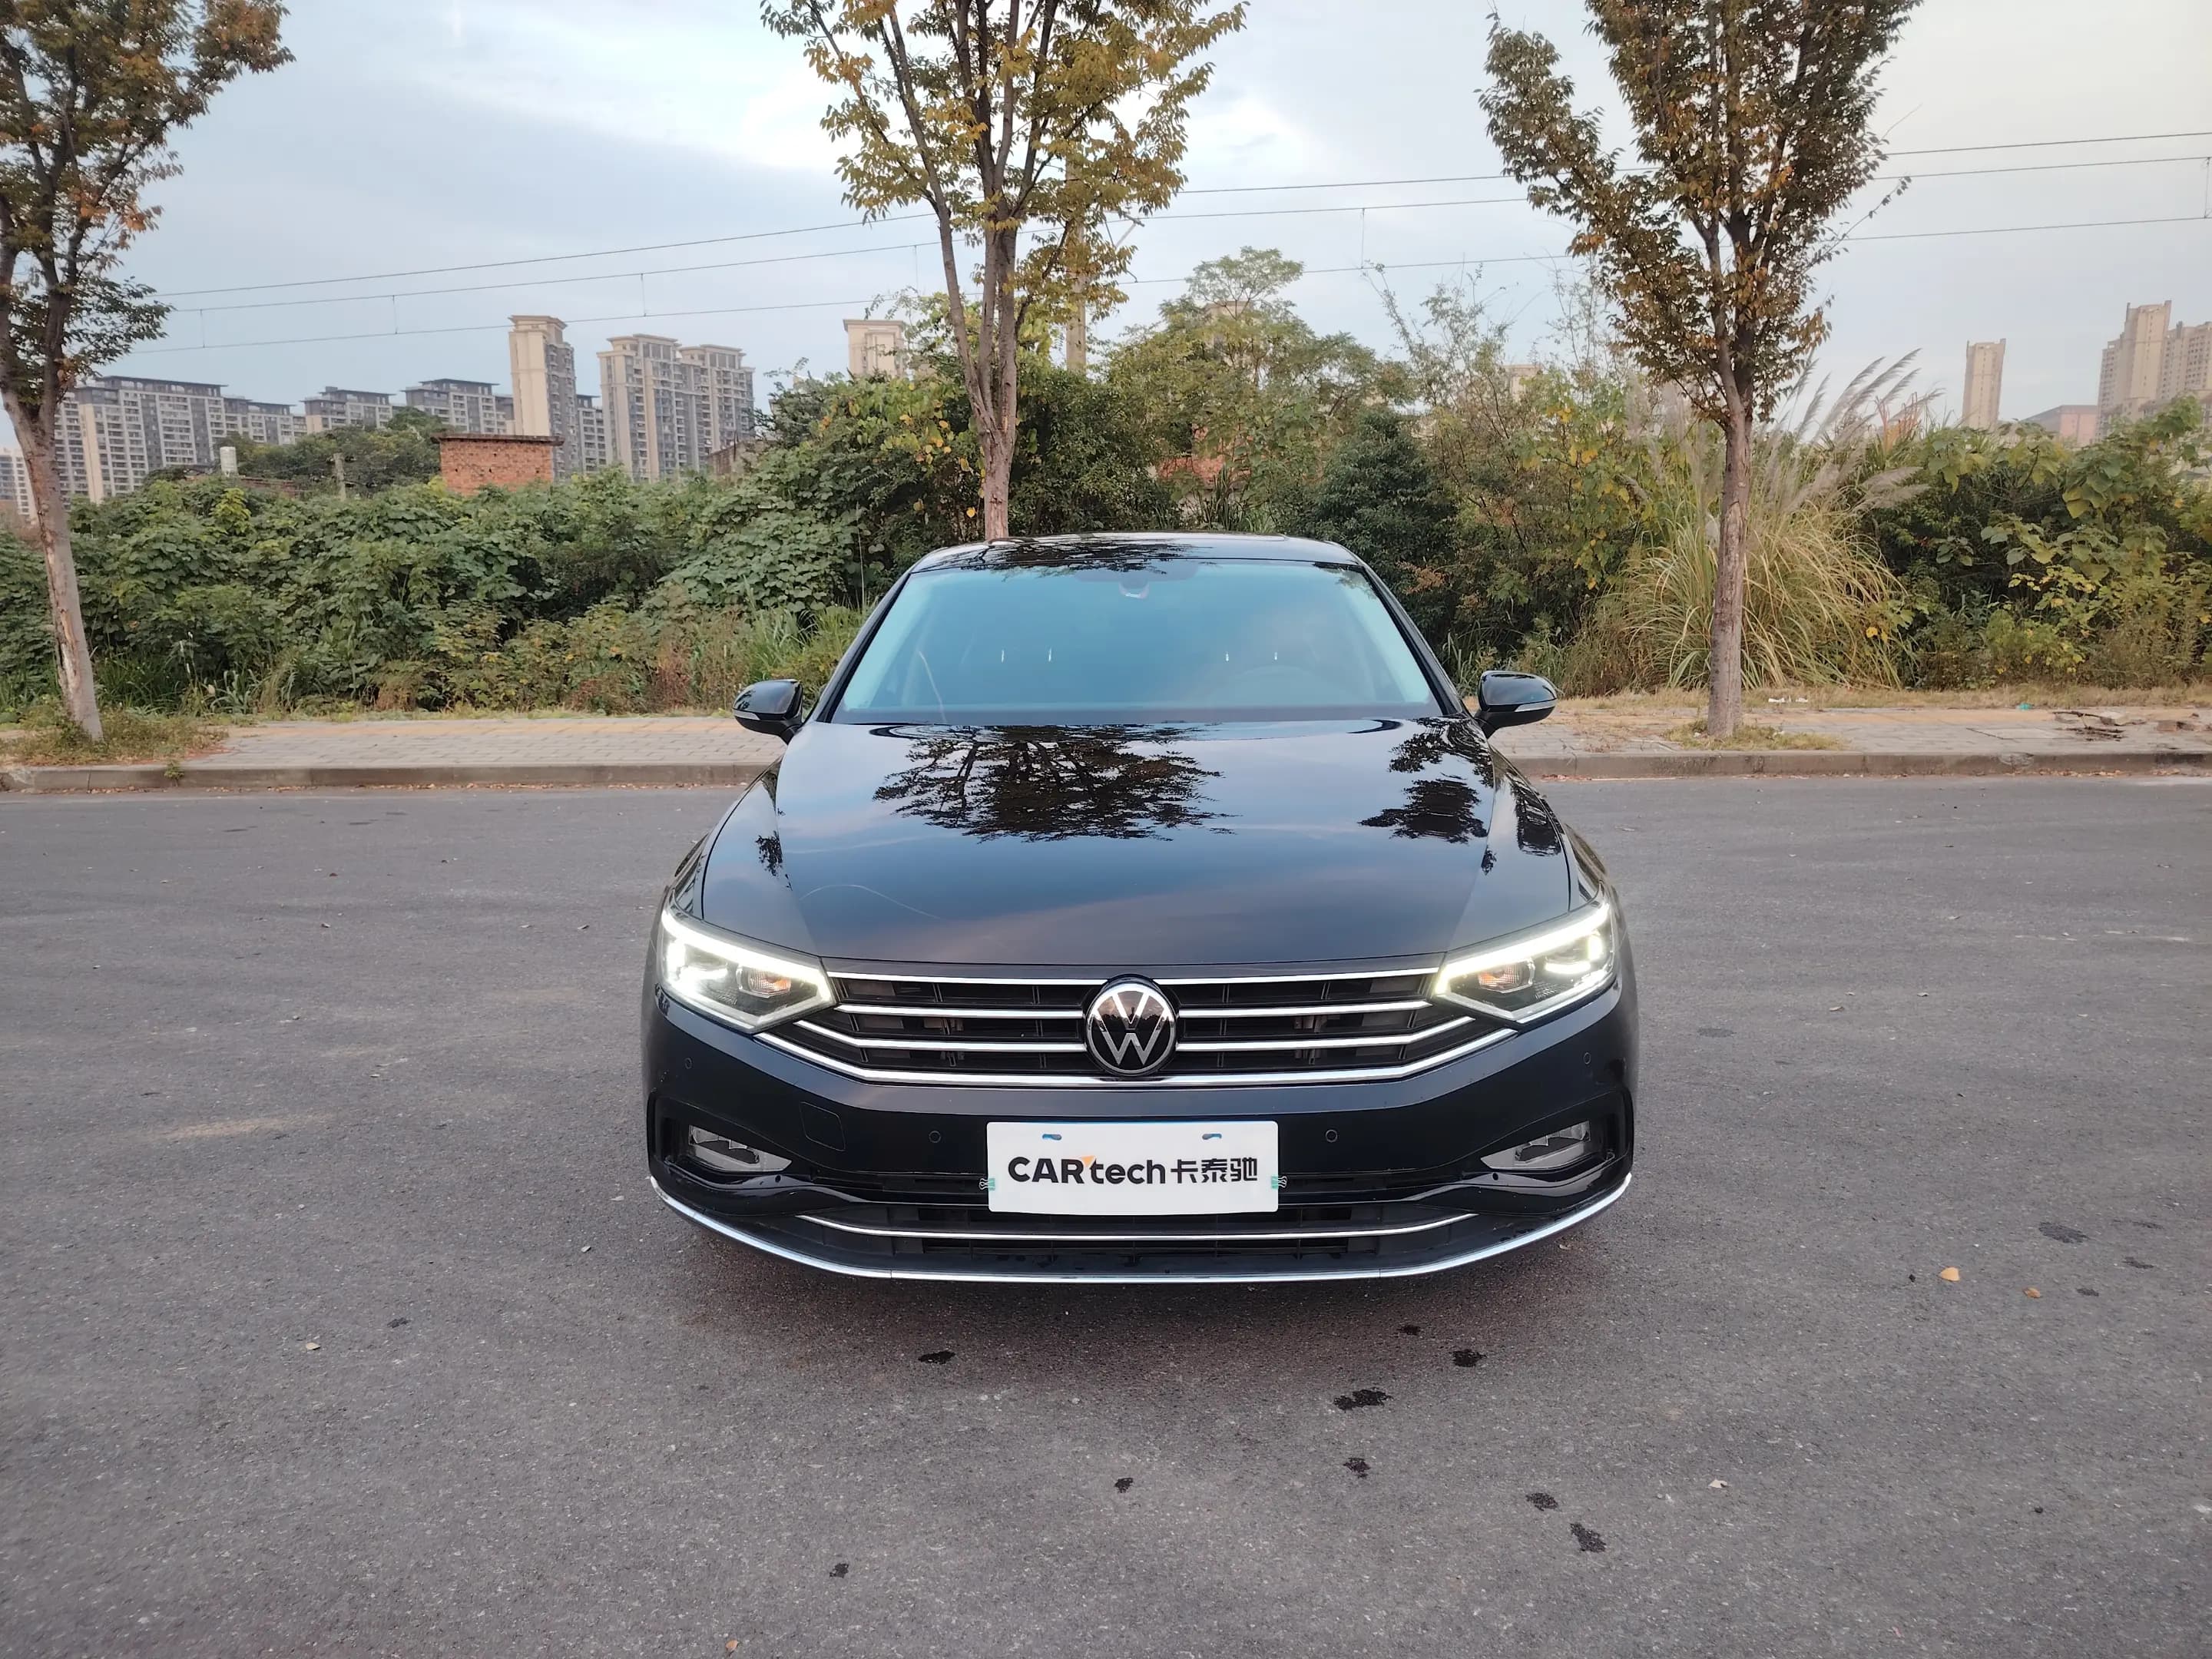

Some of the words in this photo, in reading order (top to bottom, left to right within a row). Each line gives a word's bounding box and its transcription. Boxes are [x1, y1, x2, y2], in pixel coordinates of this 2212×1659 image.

[1008, 1156, 1166, 1184] CARtech
[1170, 1157, 1258, 1184] 卡泰驰
